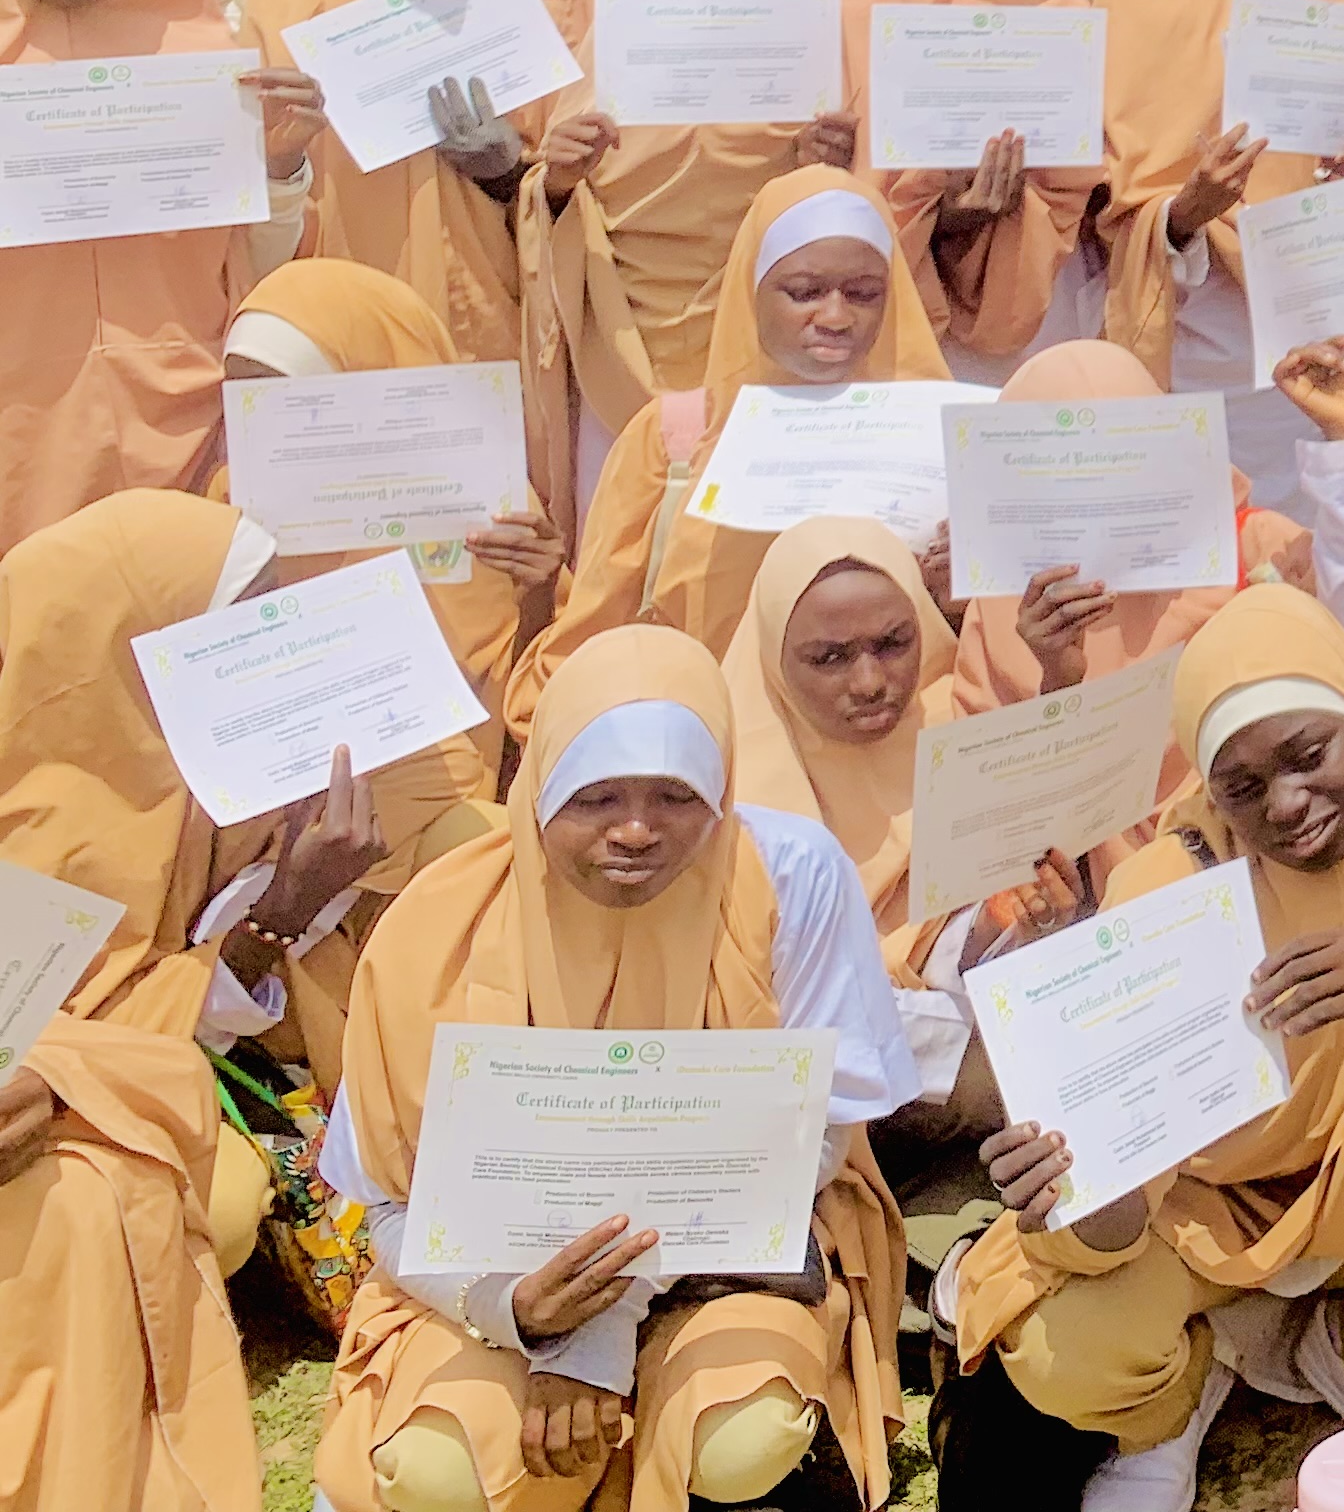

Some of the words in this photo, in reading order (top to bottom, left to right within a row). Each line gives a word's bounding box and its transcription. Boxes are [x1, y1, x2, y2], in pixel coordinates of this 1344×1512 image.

[516, 1091, 595, 1110] Certificate
[600, 1094, 615, 1110] of
[620, 1095, 721, 1113] Participation
